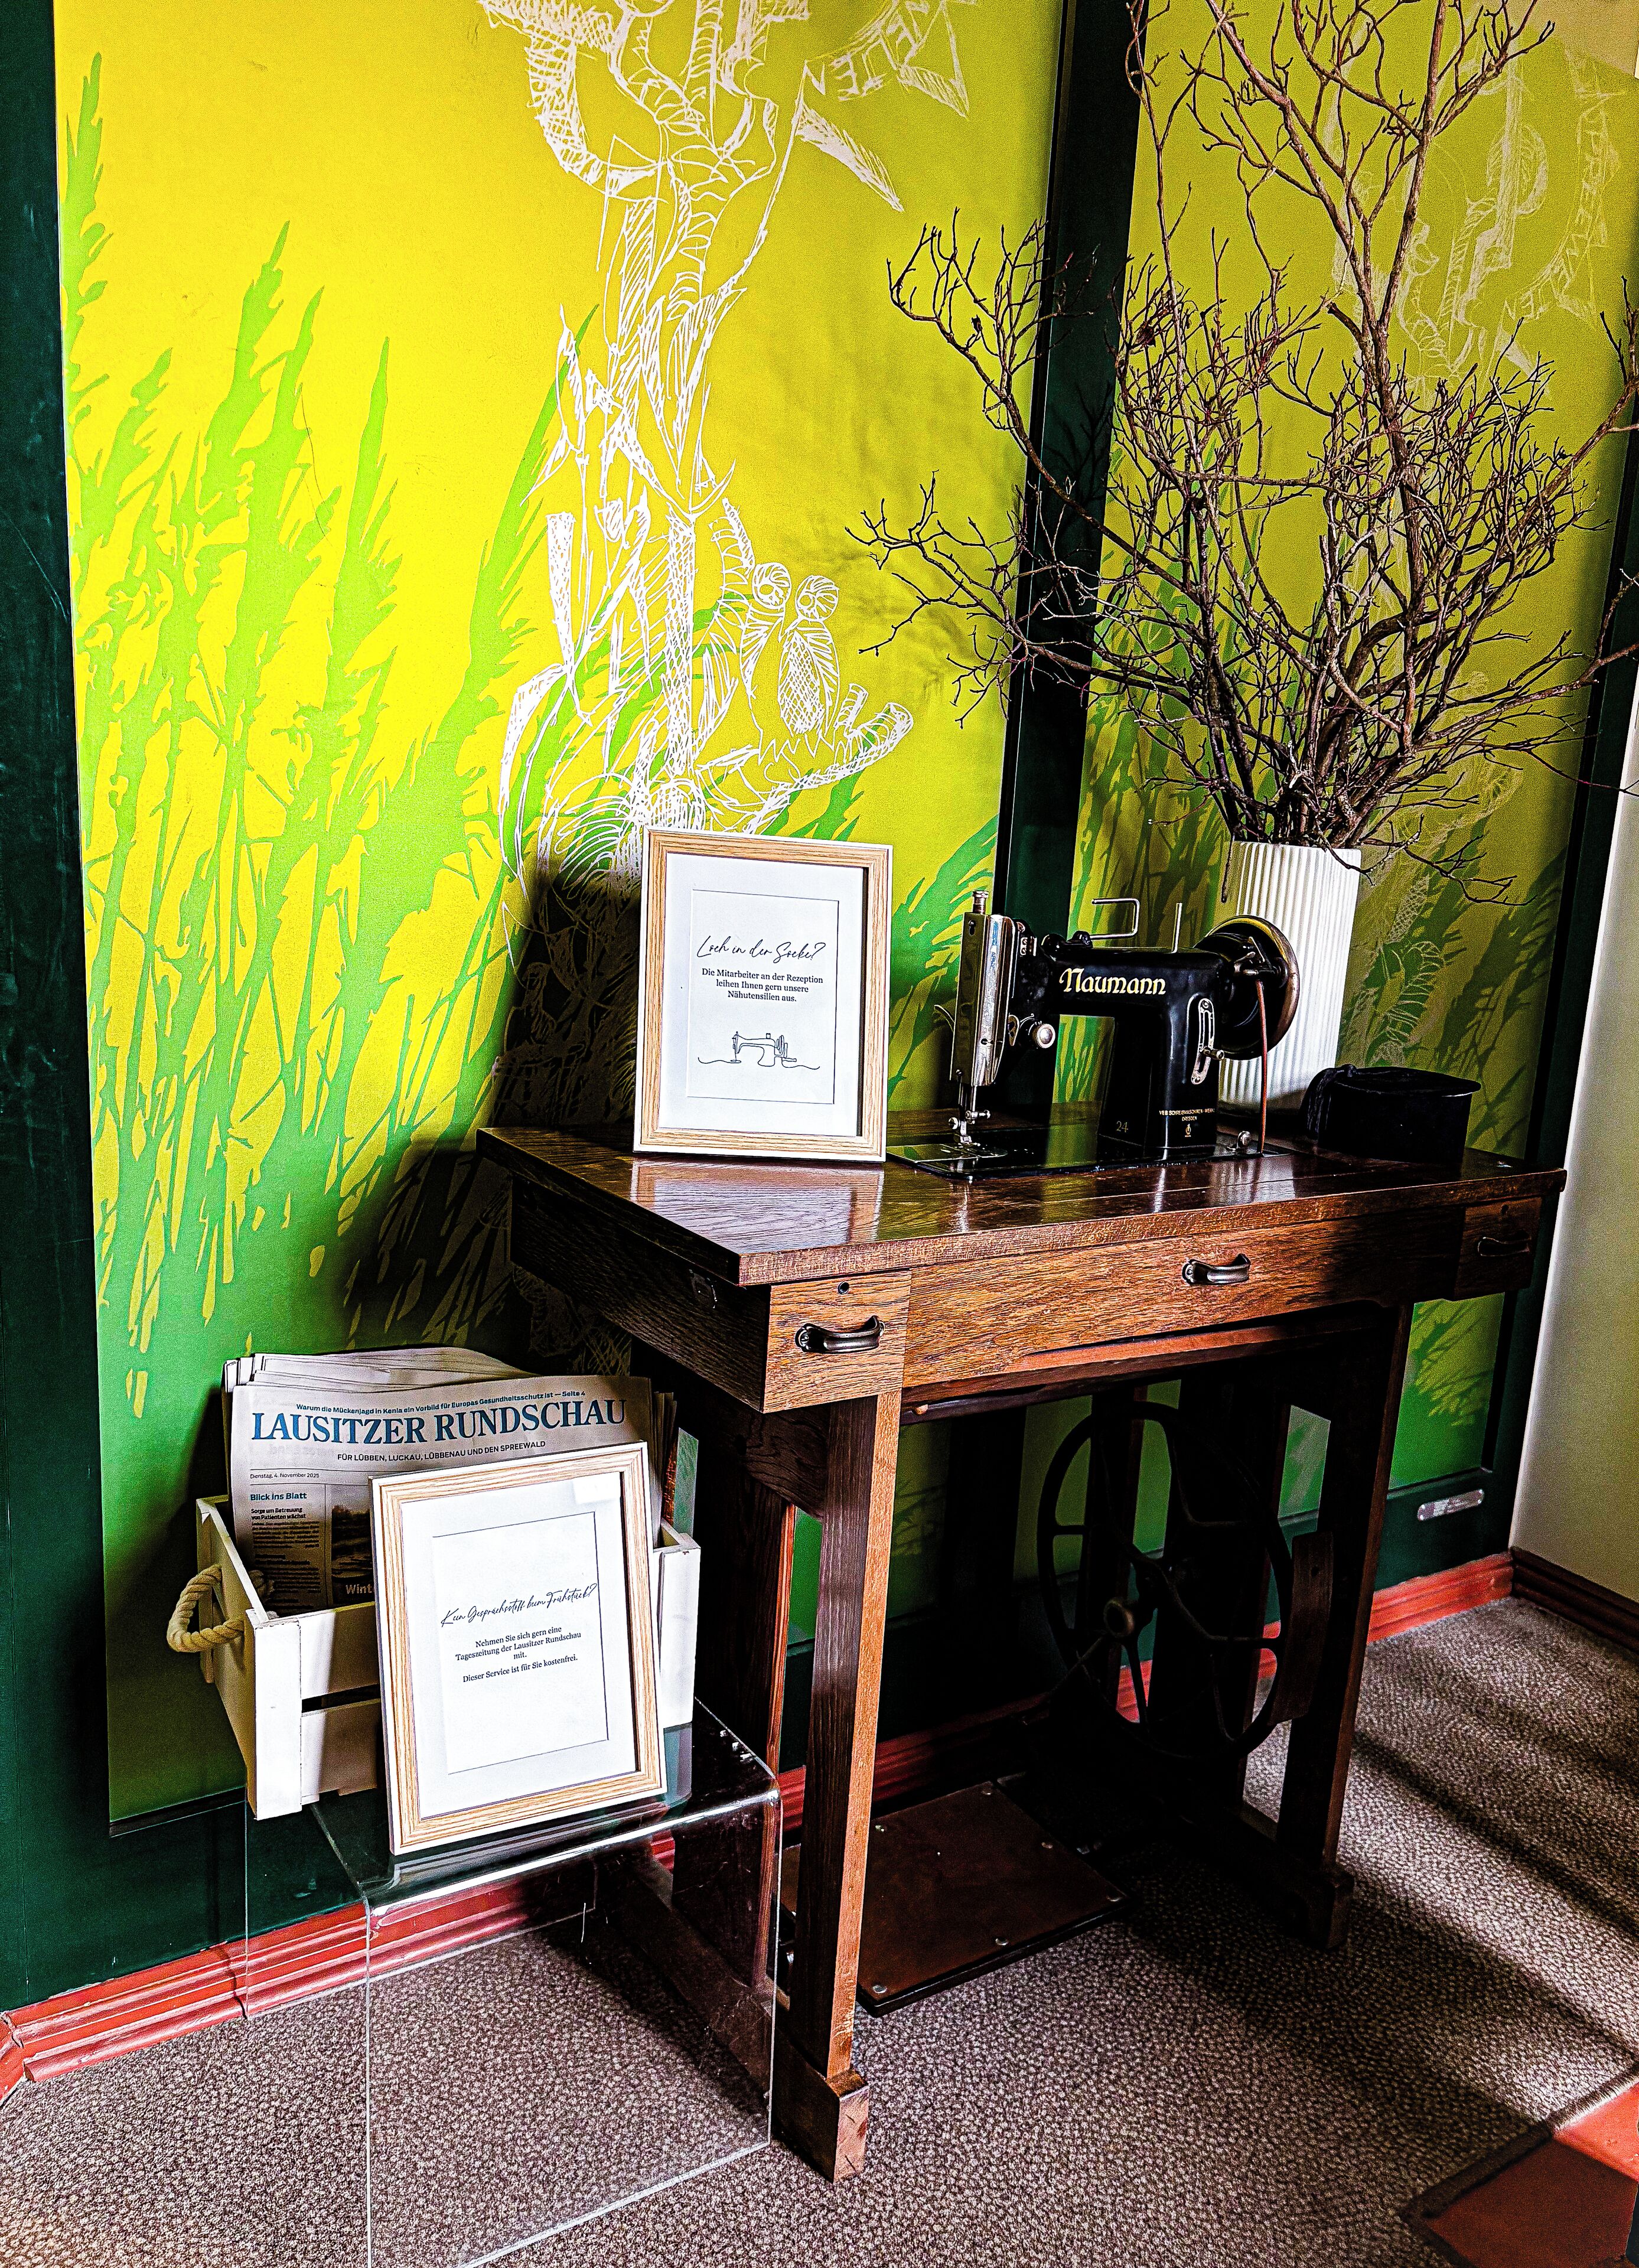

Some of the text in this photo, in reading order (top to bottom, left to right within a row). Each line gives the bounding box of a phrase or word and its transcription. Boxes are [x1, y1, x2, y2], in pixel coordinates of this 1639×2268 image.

[696, 935, 826, 964] Loch in der Socke?
[702, 967, 715, 976] Die
[716, 969, 760, 979] Mitarbeiter
[772, 972, 786, 982] der
[786, 975, 824, 985] Rezeption
[716, 979, 809, 993] leihen Ihnen gern unsere
[1058, 967, 1166, 995] Naumann
[728, 990, 780, 1002] Nähutensilien
[1116, 1120, 1129, 1133] 24
[296, 1403, 321, 1412] Warum
[333, 1406, 374, 1415] Mückenjagd
[375, 1406, 382, 1415] in
[415, 1403, 440, 1412] Vorbild
[451, 1399, 478, 1408] Europas
[479, 1393, 545, 1405] Gesundheitsschutz
[251, 1399, 627, 1445] LAUSITZER RUNDSCHAU
[337, 1452, 353, 1461] FÜR
[354, 1453, 387, 1463] LÜBBEN,
[388, 1453, 424, 1462] LUCKAU,
[424, 1448, 466, 1461] LÜBBENAU
[484, 1445, 499, 1454] DEN
[500, 1440, 546, 1452] SPREEWALD
[250, 1491, 308, 1501] Blick ins Blatt
[346, 1584, 374, 1594] Wint
[441, 1608, 465, 1627] Kein
[526, 1595, 547, 1609] beim
[455, 1632, 582, 1661] Tageszeitung der Lausitzer Rundschau
[475, 1627, 562, 1649] Nehmen Sie sich gern eine
[513, 1652, 527, 1660] mit.
[462, 1673, 485, 1683] Dieser
[485, 1666, 510, 1679] Service
[520, 1662, 532, 1672] für
[543, 1653, 578, 1667] kostenfrei.
